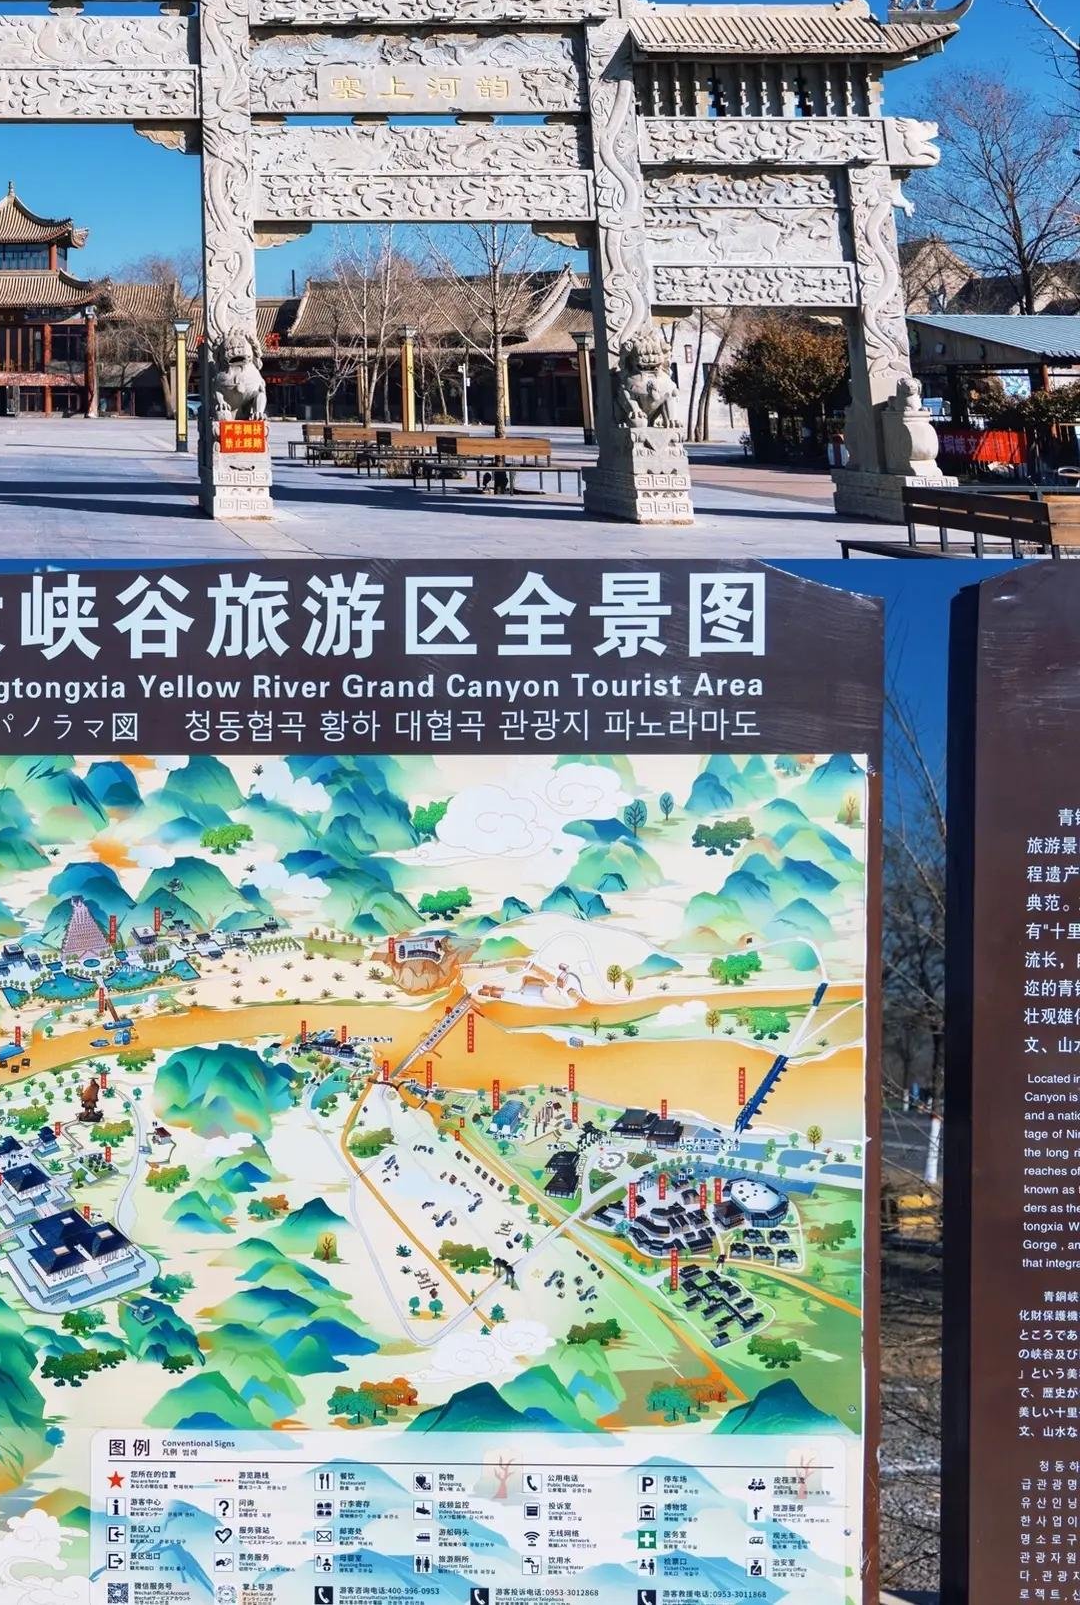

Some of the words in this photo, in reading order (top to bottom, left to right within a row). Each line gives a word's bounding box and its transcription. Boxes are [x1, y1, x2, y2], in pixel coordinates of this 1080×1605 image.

[329, 75, 512, 101] 塞上河韵
[138, 674, 241, 698] Yellow
[253, 674, 330, 698] River
[342, 674, 435, 698] Grand
[447, 674, 560, 703] Canyon
[572, 673, 682, 698] Tourist
[694, 673, 763, 697] Area
[184, 710, 306, 743] 청동협곡
[320, 710, 381, 742] 황하
[394, 710, 486, 742] 대협곡
[498, 709, 591, 742] 관광지
[604, 709, 761, 742] 파노라마도
[1026, 865, 1080, 883] 程遗产
[1027, 1073, 1071, 1084] Located
[1024, 1092, 1066, 1103] Canyon
[1069, 1092, 1078, 1102] is
[1024, 1111, 1045, 1121] and
[1047, 1113, 1055, 1121] a
[1024, 1130, 1048, 1141] tage
[1052, 1130, 1063, 1139] of
[1024, 1148, 1041, 1158] the
[1046, 1148, 1069, 1160] long
[1024, 1166, 1067, 1176] reaches
[1024, 1185, 1058, 1194] known
[1062, 1186, 1075, 1194] as
[1024, 1203, 1047, 1213] ders
[1050, 1205, 1063, 1213] as
[1023, 1222, 1063, 1234] tongxia
[1023, 1240, 1057, 1252] Gorge
[1022, 1259, 1042, 1268] that
[1019, 1329, 1078, 1341] ところであ
[1018, 1426, 1078, 1438] 文、山水な
[108, 1439, 151, 1457] 图例
[162, 1440, 213, 1448] Conventional
[214, 1440, 236, 1449] Signs
[130, 1470, 177, 1479] 您所在的位置
[238, 1471, 270, 1480] 游览路线
[340, 1473, 355, 1481] 餐饮
[438, 1473, 454, 1481] 购物
[547, 1474, 578, 1482] 公用电话
[238, 1499, 255, 1507] 问询
[438, 1501, 470, 1509] 视频监控
[548, 1502, 572, 1510] 投诉室
[663, 1503, 688, 1511] 博物馆
[772, 1504, 804, 1512] 旅游服务
[130, 1525, 161, 1533] 景区入口
[238, 1526, 270, 1534] 服务驿站
[339, 1528, 362, 1536] 邮寄处
[438, 1528, 470, 1536] 游船码头
[663, 1531, 687, 1539] 医务室
[130, 1552, 161, 1560] 景区出口
[238, 1553, 270, 1561] 票务服务
[339, 1554, 362, 1562] 母婴室
[438, 1555, 469, 1563] 旅游厕所
[548, 1556, 572, 1564] 饮用水
[663, 1557, 688, 1565] 检票口
[772, 1558, 796, 1566] 治安室
[134, 1582, 172, 1590] 微信服务号
[242, 1583, 273, 1591] 掌上导游
